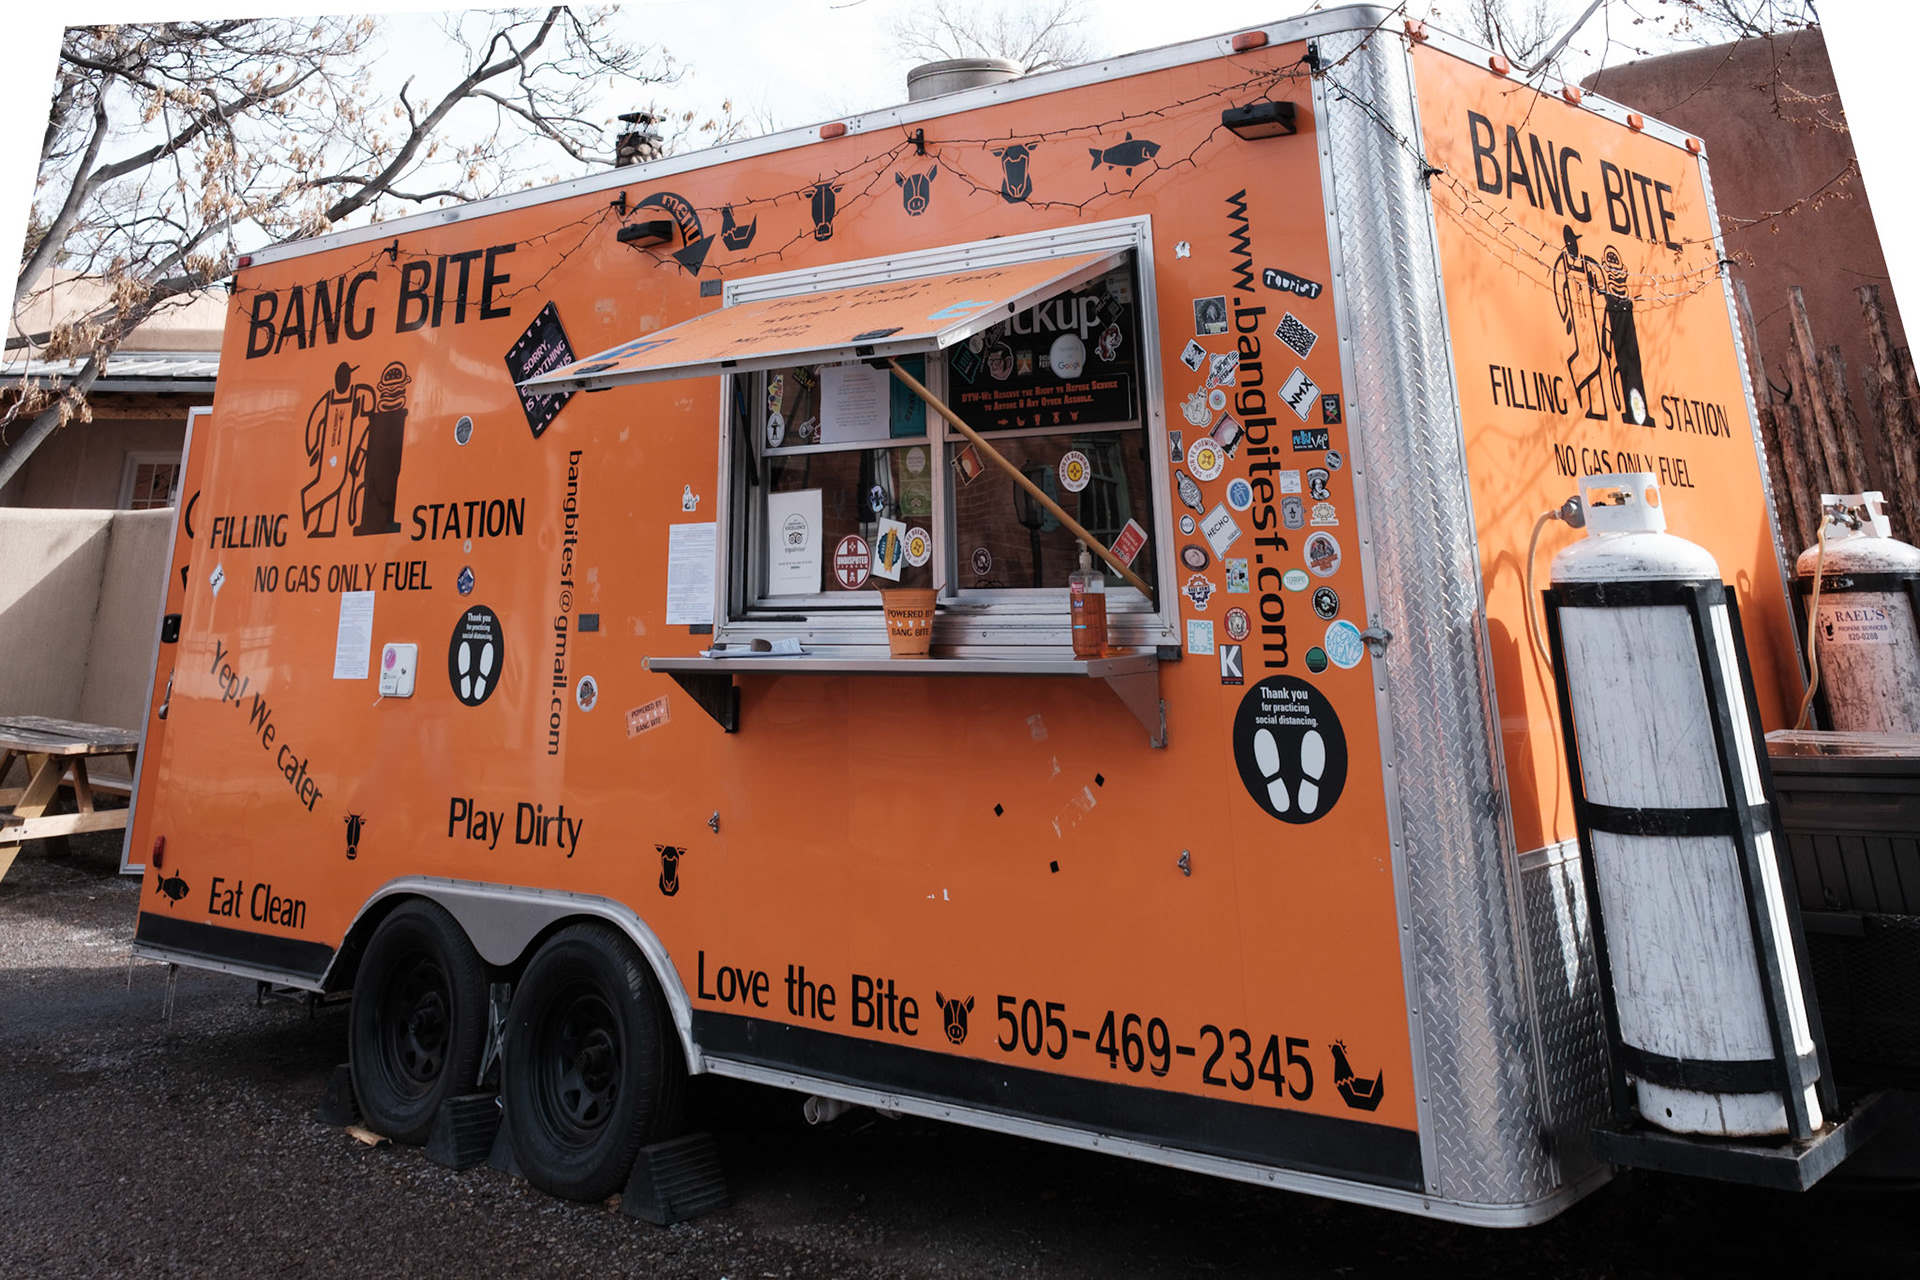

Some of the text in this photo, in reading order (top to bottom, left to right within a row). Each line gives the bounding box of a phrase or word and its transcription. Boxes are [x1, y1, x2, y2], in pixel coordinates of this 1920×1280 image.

[1467, 110, 1684, 252] BANG BITE
[661, 195, 702, 247] menu
[246, 243, 517, 360] BANG BITE
[522, 340, 551, 374] SORRY,
[1288, 376, 1314, 411] NMX
[1489, 364, 1731, 439] FILLING STATION
[1225, 188, 1289, 668] www.bangbitesf.com
[1554, 443, 1577, 477] NO
[1582, 447, 1612, 477] GAS
[1659, 456, 1695, 488] FUEL
[210, 513, 289, 550] FILLING
[410, 498, 526, 542] STATION
[1207, 515, 1230, 539] HECHO
[254, 559, 433, 594] NO GAS ONLY FUEL
[467, 613, 492, 624] Thank you
[547, 450, 582, 756] bangbitesf@gmail.com
[888, 609, 923, 618] POWERED
[1835, 609, 1886, 622] RAEL'S
[892, 628, 930, 637] BANG BITE
[631, 702, 655, 718] POWERED
[1260, 686, 1309, 702] Thank you
[1261, 701, 1310, 715] for practicing
[210, 639, 323, 813] Yep! We cater
[636, 717, 662, 733] BANG BITE
[1255, 715, 1319, 728] social distancing.
[448, 797, 584, 858] Play Dirty
[208, 876, 307, 929] Eat Clean
[698, 950, 1315, 1102] Love the Bite 505-469-2345
